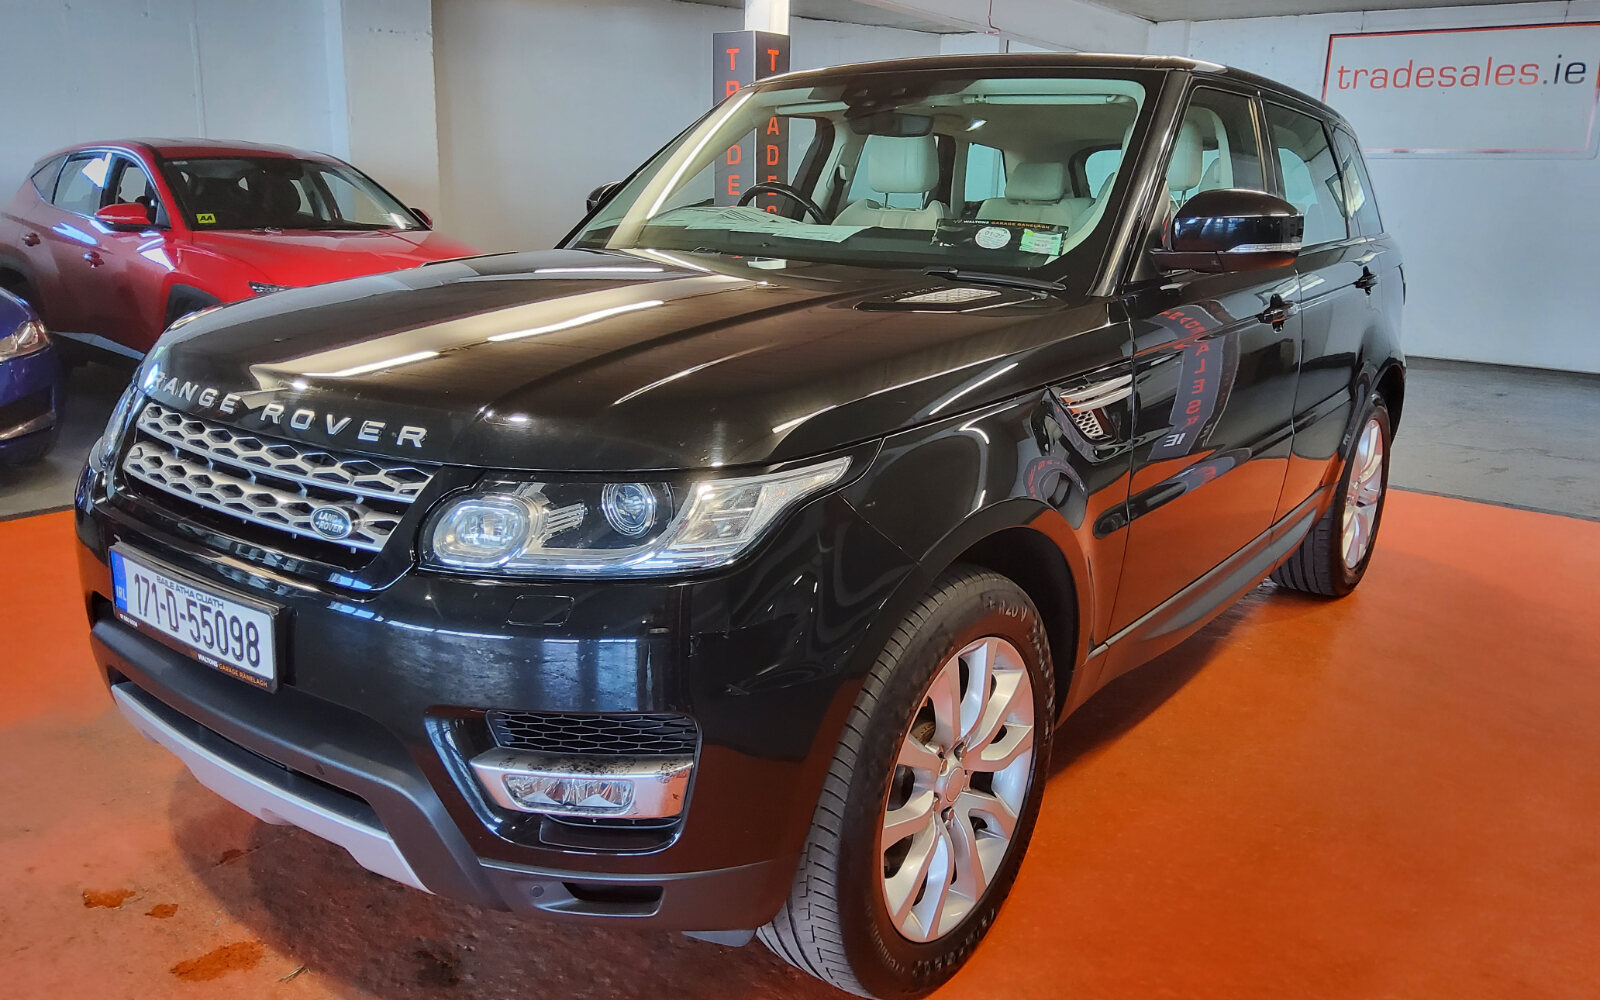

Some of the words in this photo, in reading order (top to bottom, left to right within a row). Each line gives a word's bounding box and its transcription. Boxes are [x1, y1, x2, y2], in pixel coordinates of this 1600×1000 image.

[1337, 54, 1587, 90] tradesales.ie
[155, 370, 242, 415] RANGE
[260, 402, 429, 448] ROVER
[318, 511, 339, 522] LAND
[319, 520, 344, 533] ROVER
[116, 585, 127, 601] IRL
[134, 573, 260, 668] 171-D-55098
[218, 663, 239, 676] GARAGE
